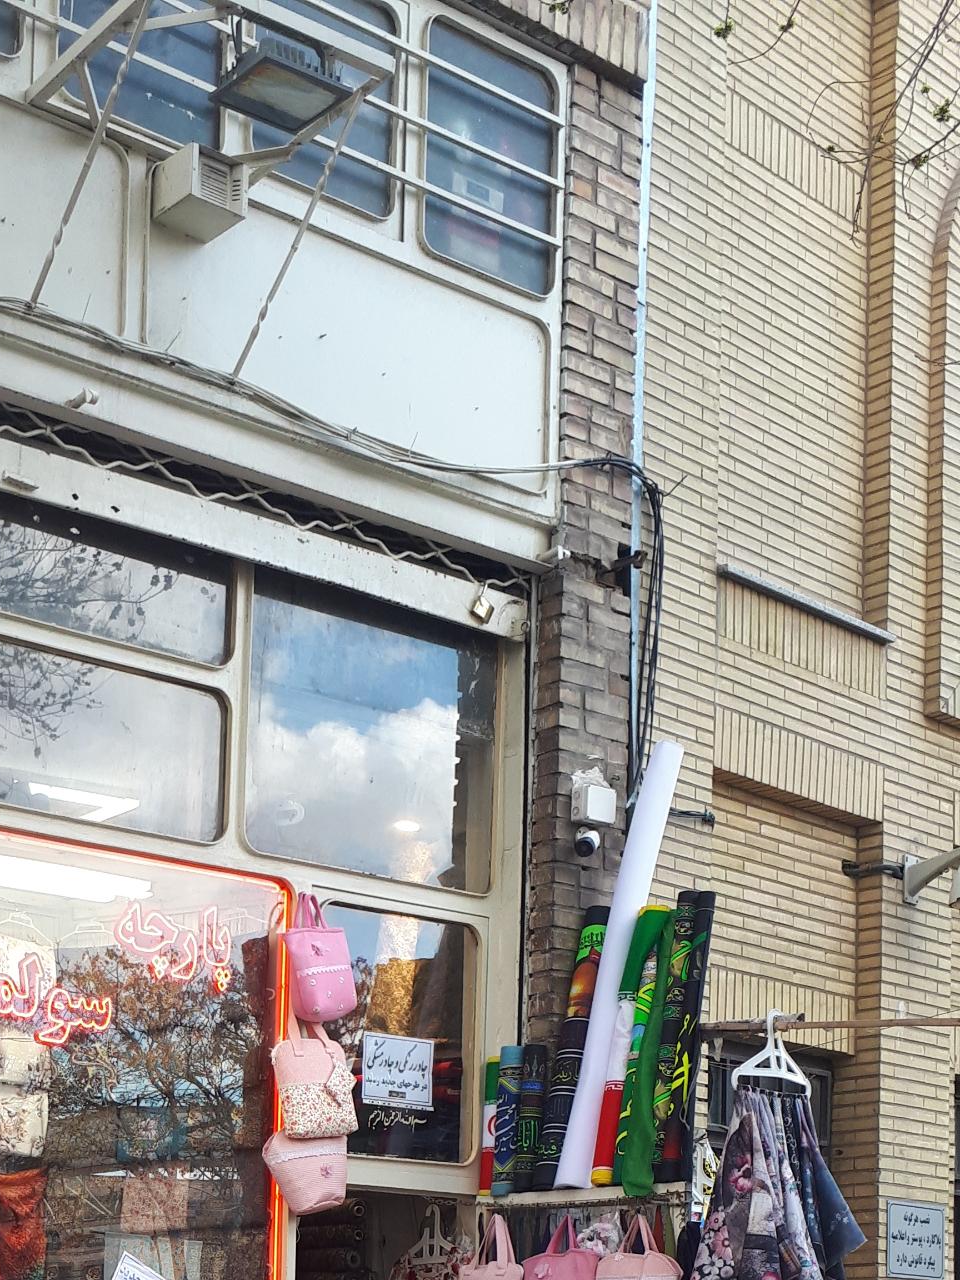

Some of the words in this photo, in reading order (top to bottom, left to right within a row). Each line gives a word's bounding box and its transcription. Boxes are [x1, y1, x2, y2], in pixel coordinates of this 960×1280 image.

[116, 901, 232, 991] پارچه
[367, 1040, 386, 1069] مشکی
[379, 1056, 394, 1075] چادر
[412, 1059, 428, 1079] چادر
